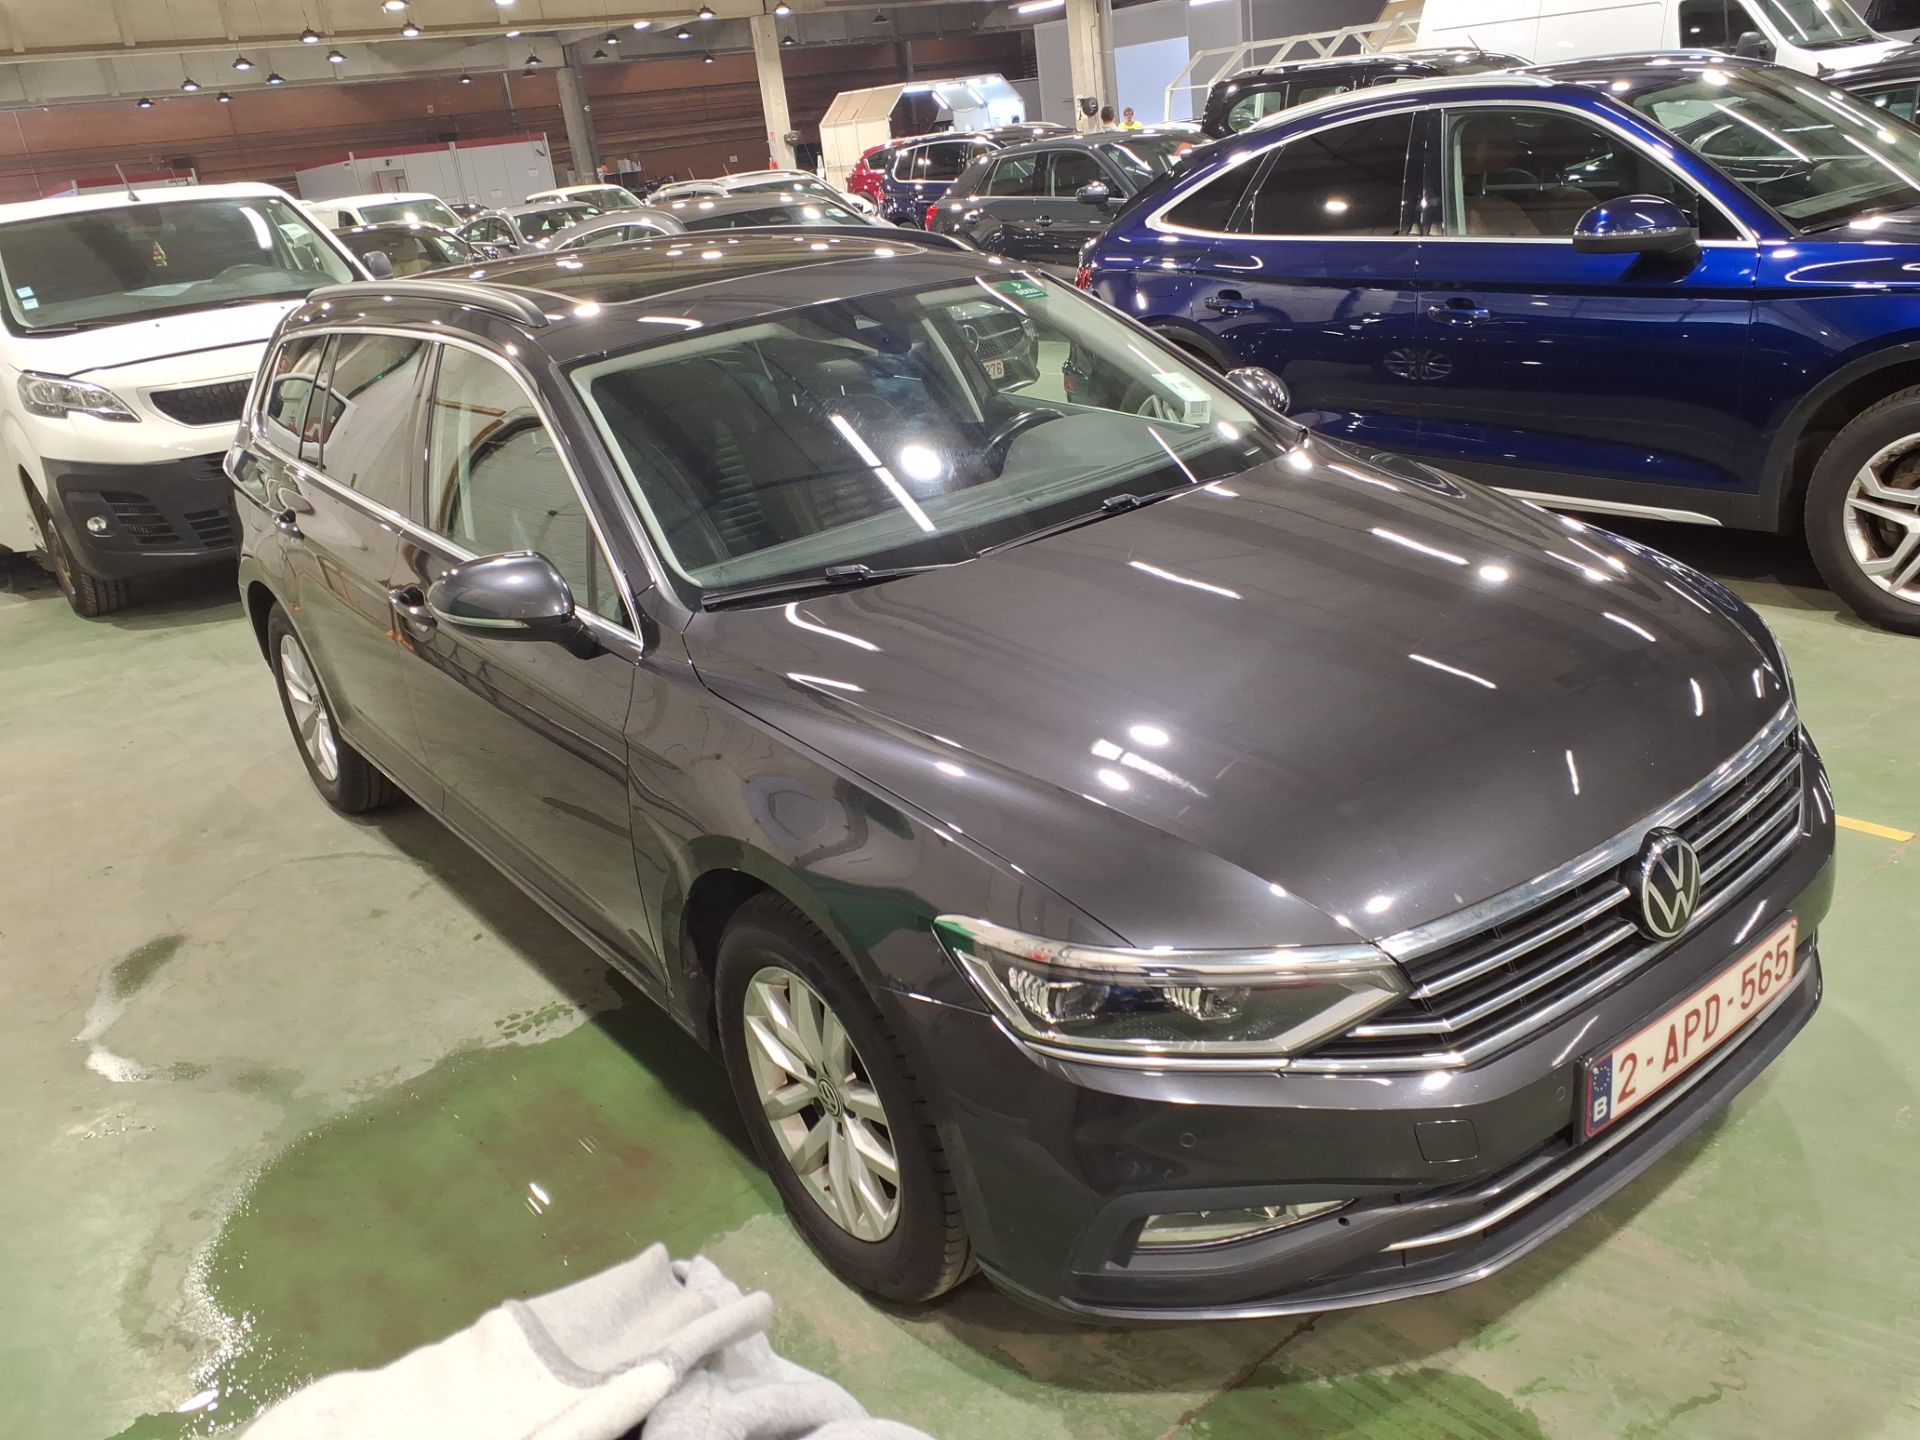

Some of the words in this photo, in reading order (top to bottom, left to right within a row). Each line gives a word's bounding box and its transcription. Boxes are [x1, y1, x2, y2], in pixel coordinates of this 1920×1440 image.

[1644, 838, 1699, 935] VW
[1593, 1096, 1608, 1122] B
[1617, 934, 1790, 1105] 2-APD-565
